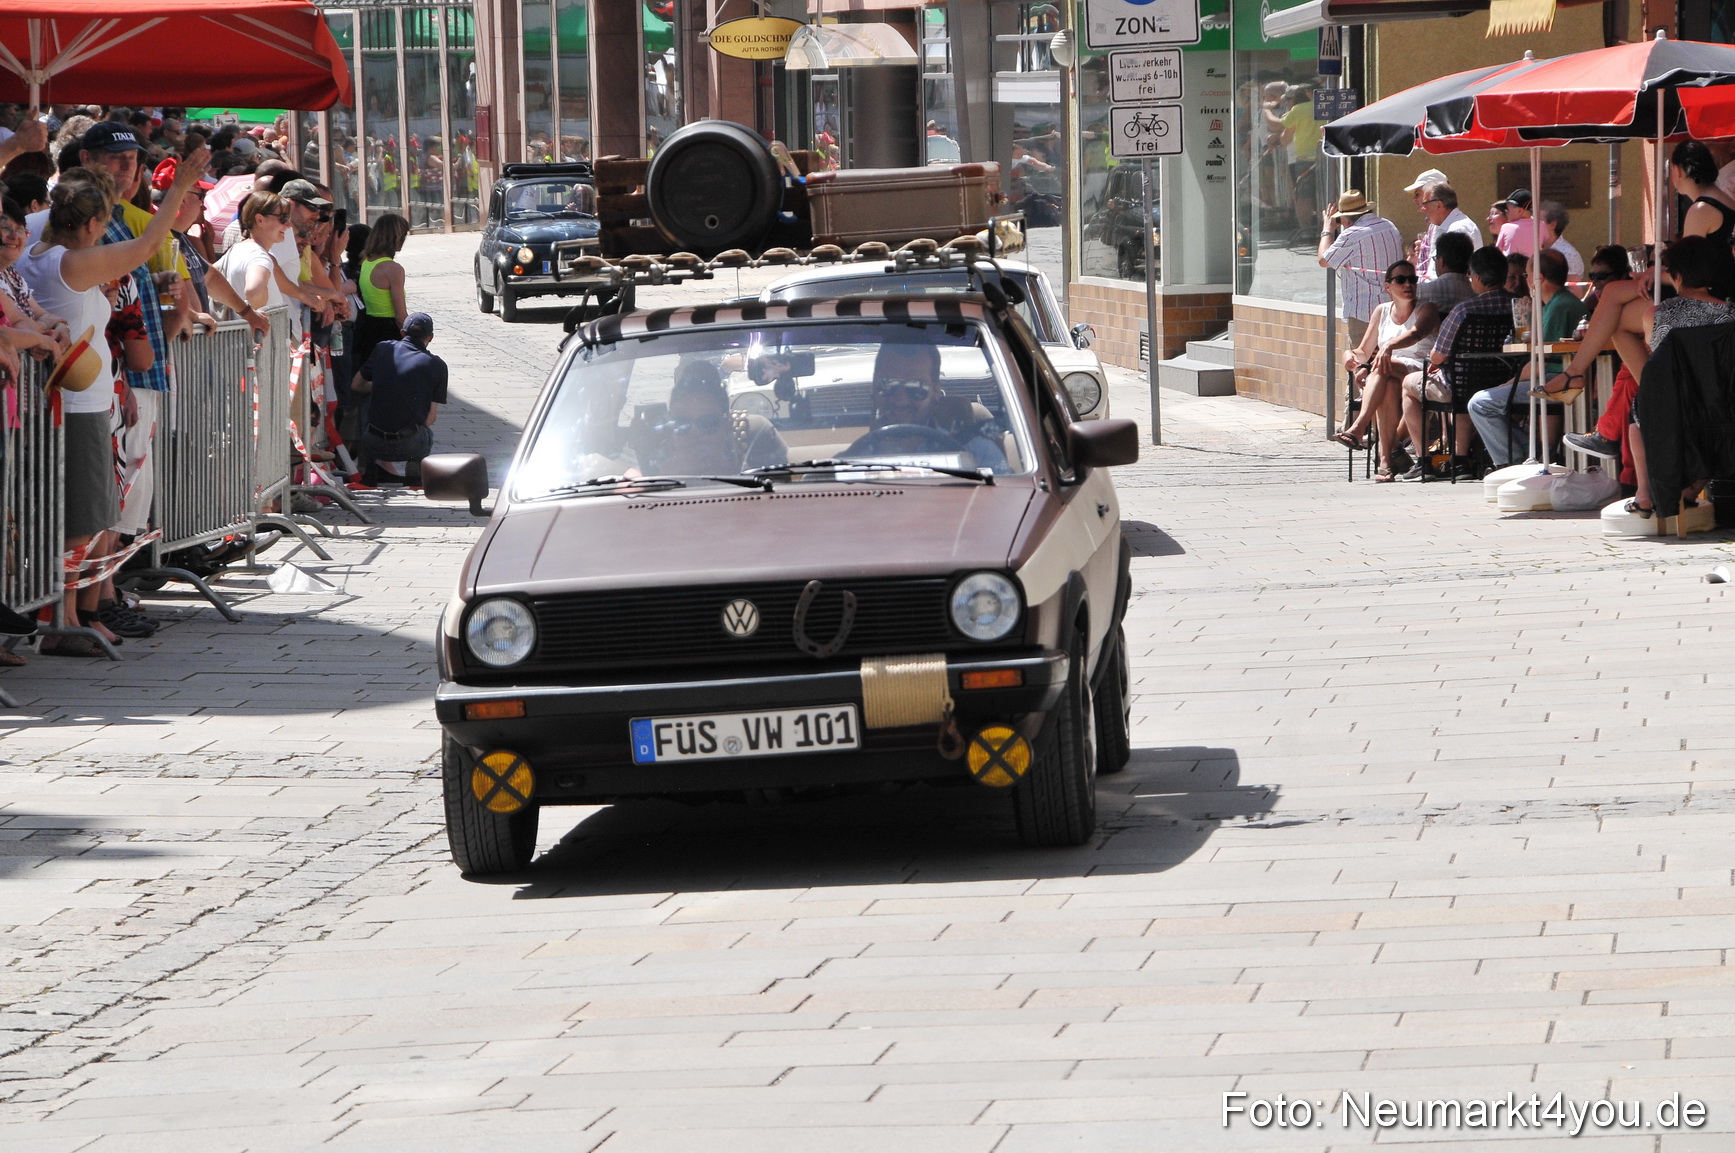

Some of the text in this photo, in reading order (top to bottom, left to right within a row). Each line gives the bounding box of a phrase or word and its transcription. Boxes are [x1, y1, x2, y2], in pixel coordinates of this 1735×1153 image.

[715, 35, 732, 43] DIE
[1138, 84, 1156, 94] frei
[1136, 138, 1158, 151] frei
[741, 715, 783, 750] VW
[794, 710, 855, 748] 101
[640, 745, 649, 755] D
